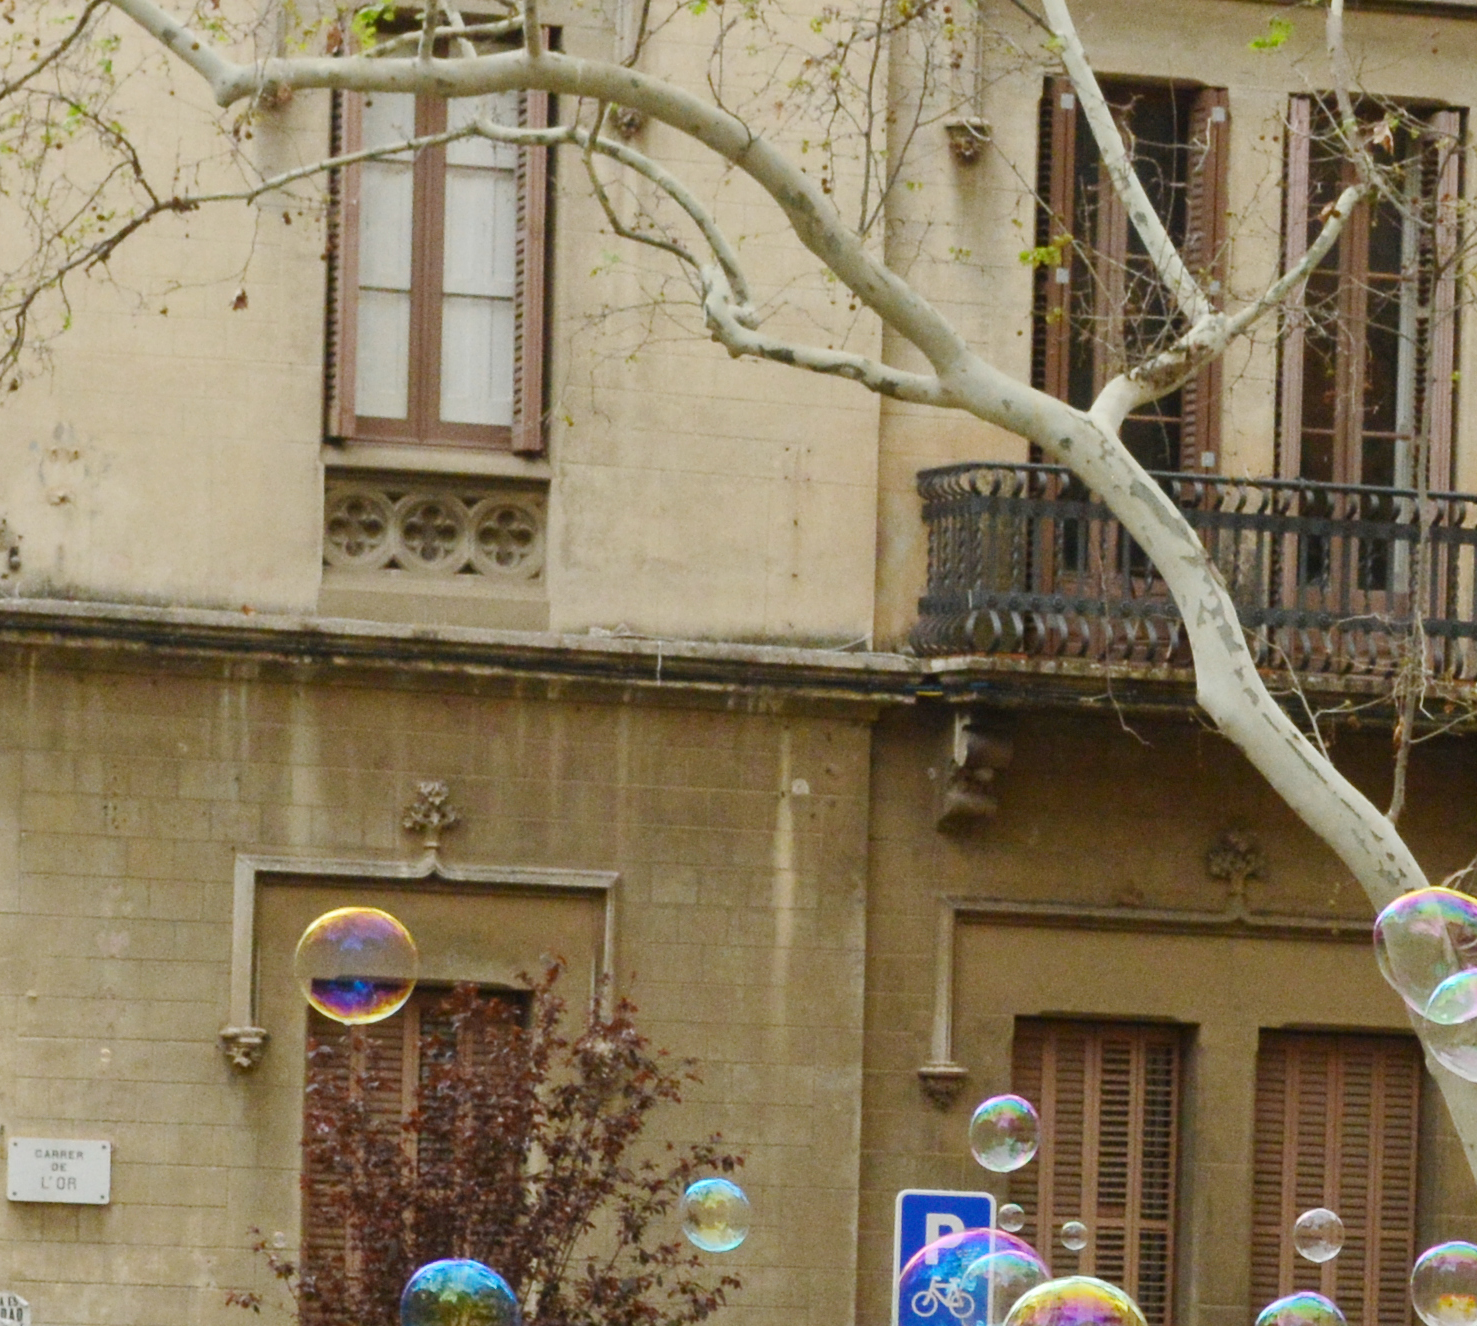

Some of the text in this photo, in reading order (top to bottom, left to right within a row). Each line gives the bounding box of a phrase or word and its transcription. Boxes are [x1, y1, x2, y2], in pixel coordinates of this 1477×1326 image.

[34, 1148, 84, 1160] CARRER
[50, 1162, 67, 1172] DE
[40, 1175, 77, 1190] L'OR
[924, 1213, 965, 1265] P
